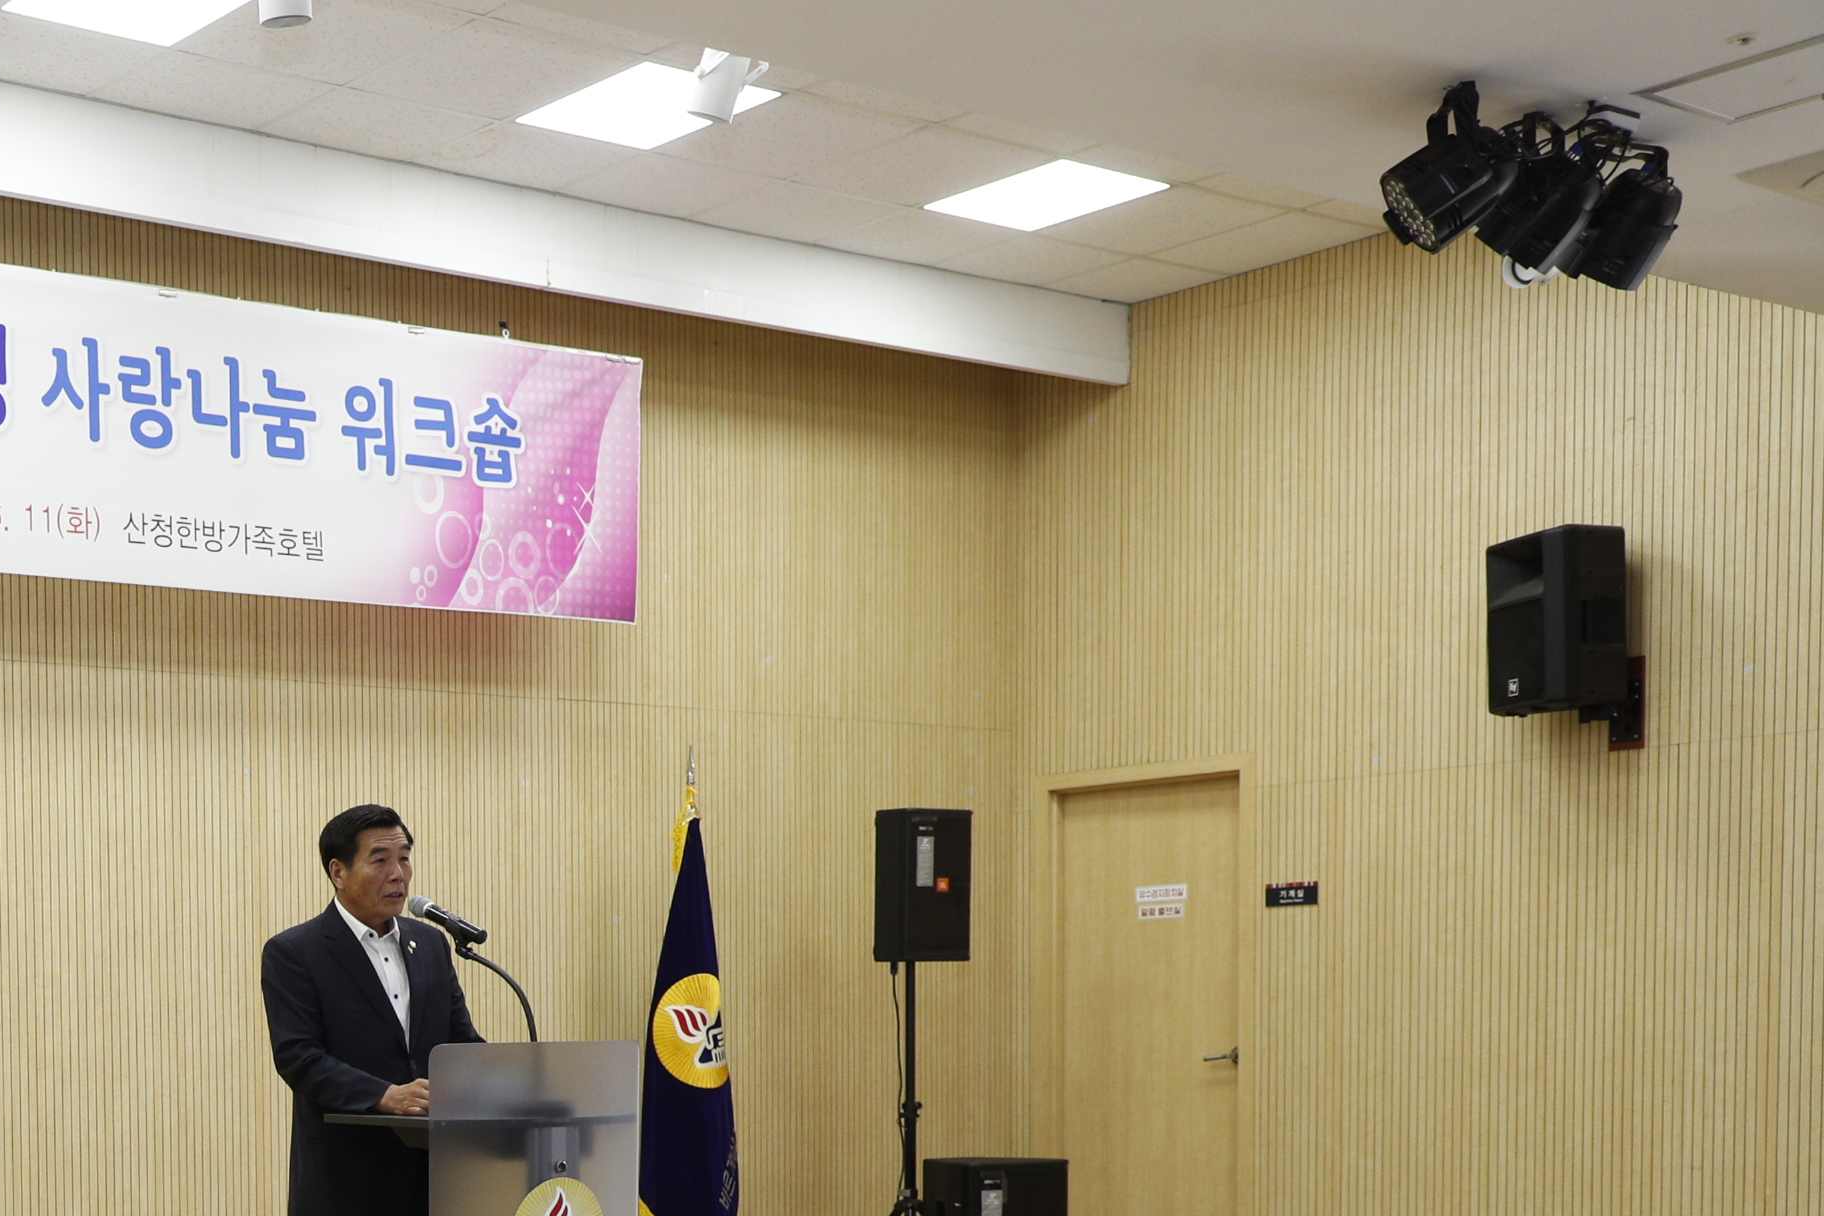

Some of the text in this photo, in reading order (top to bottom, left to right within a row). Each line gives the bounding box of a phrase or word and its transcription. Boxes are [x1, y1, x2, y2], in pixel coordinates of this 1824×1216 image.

[41, 336, 317, 463] 사랑나눔
[340, 377, 523, 486] 워크숍
[25, 503, 101, 542] 11(화)
[122, 512, 325, 562] 산청한방가족호텔
